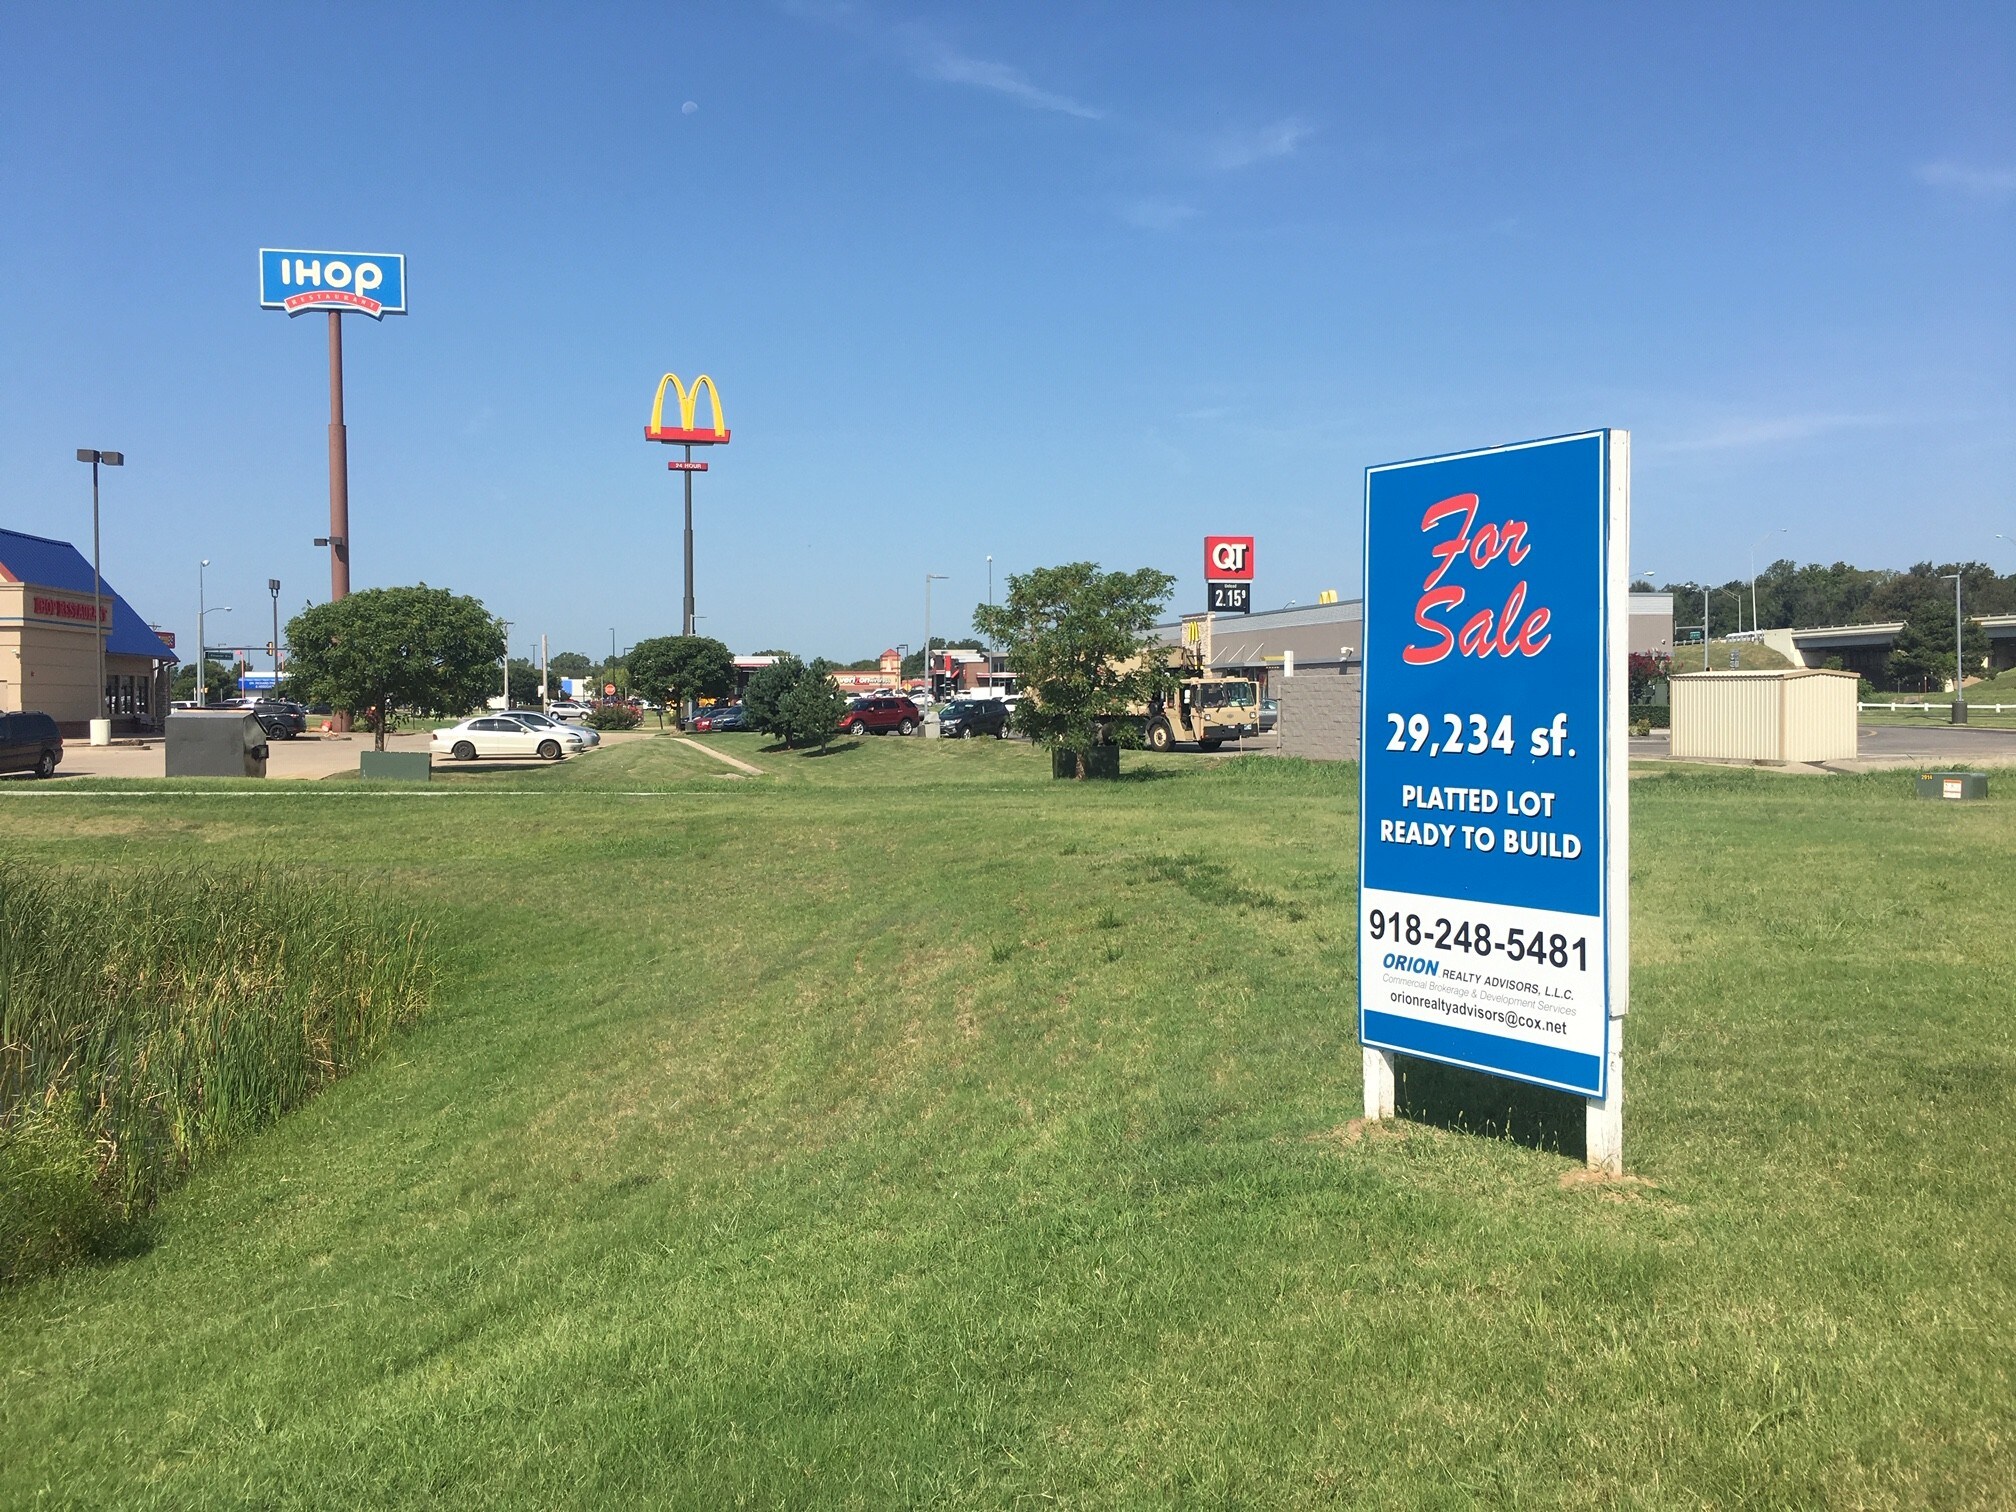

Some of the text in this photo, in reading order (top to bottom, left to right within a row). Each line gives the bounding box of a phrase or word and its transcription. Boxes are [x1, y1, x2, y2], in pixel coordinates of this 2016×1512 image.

[291, 292, 376, 310] RESTAURANT
[1212, 542, 1248, 572] QT
[1421, 492, 1531, 592] For
[1402, 580, 1551, 666] Sale
[1385, 712, 1577, 758] 29,234 sf.
[1402, 784, 1556, 818] PLATTED LOT
[1380, 819, 1582, 859] READY TO BUILD
[1369, 908, 1587, 972] 918-248-5481
[1382, 952, 1575, 1001] ORION REALTY ADVISORS, L.L.C.
[1382, 973, 1577, 1017] Commercial Brokerage & Development Services
[1390, 990, 1567, 1036] orionrealtyadvisors@cox.net
